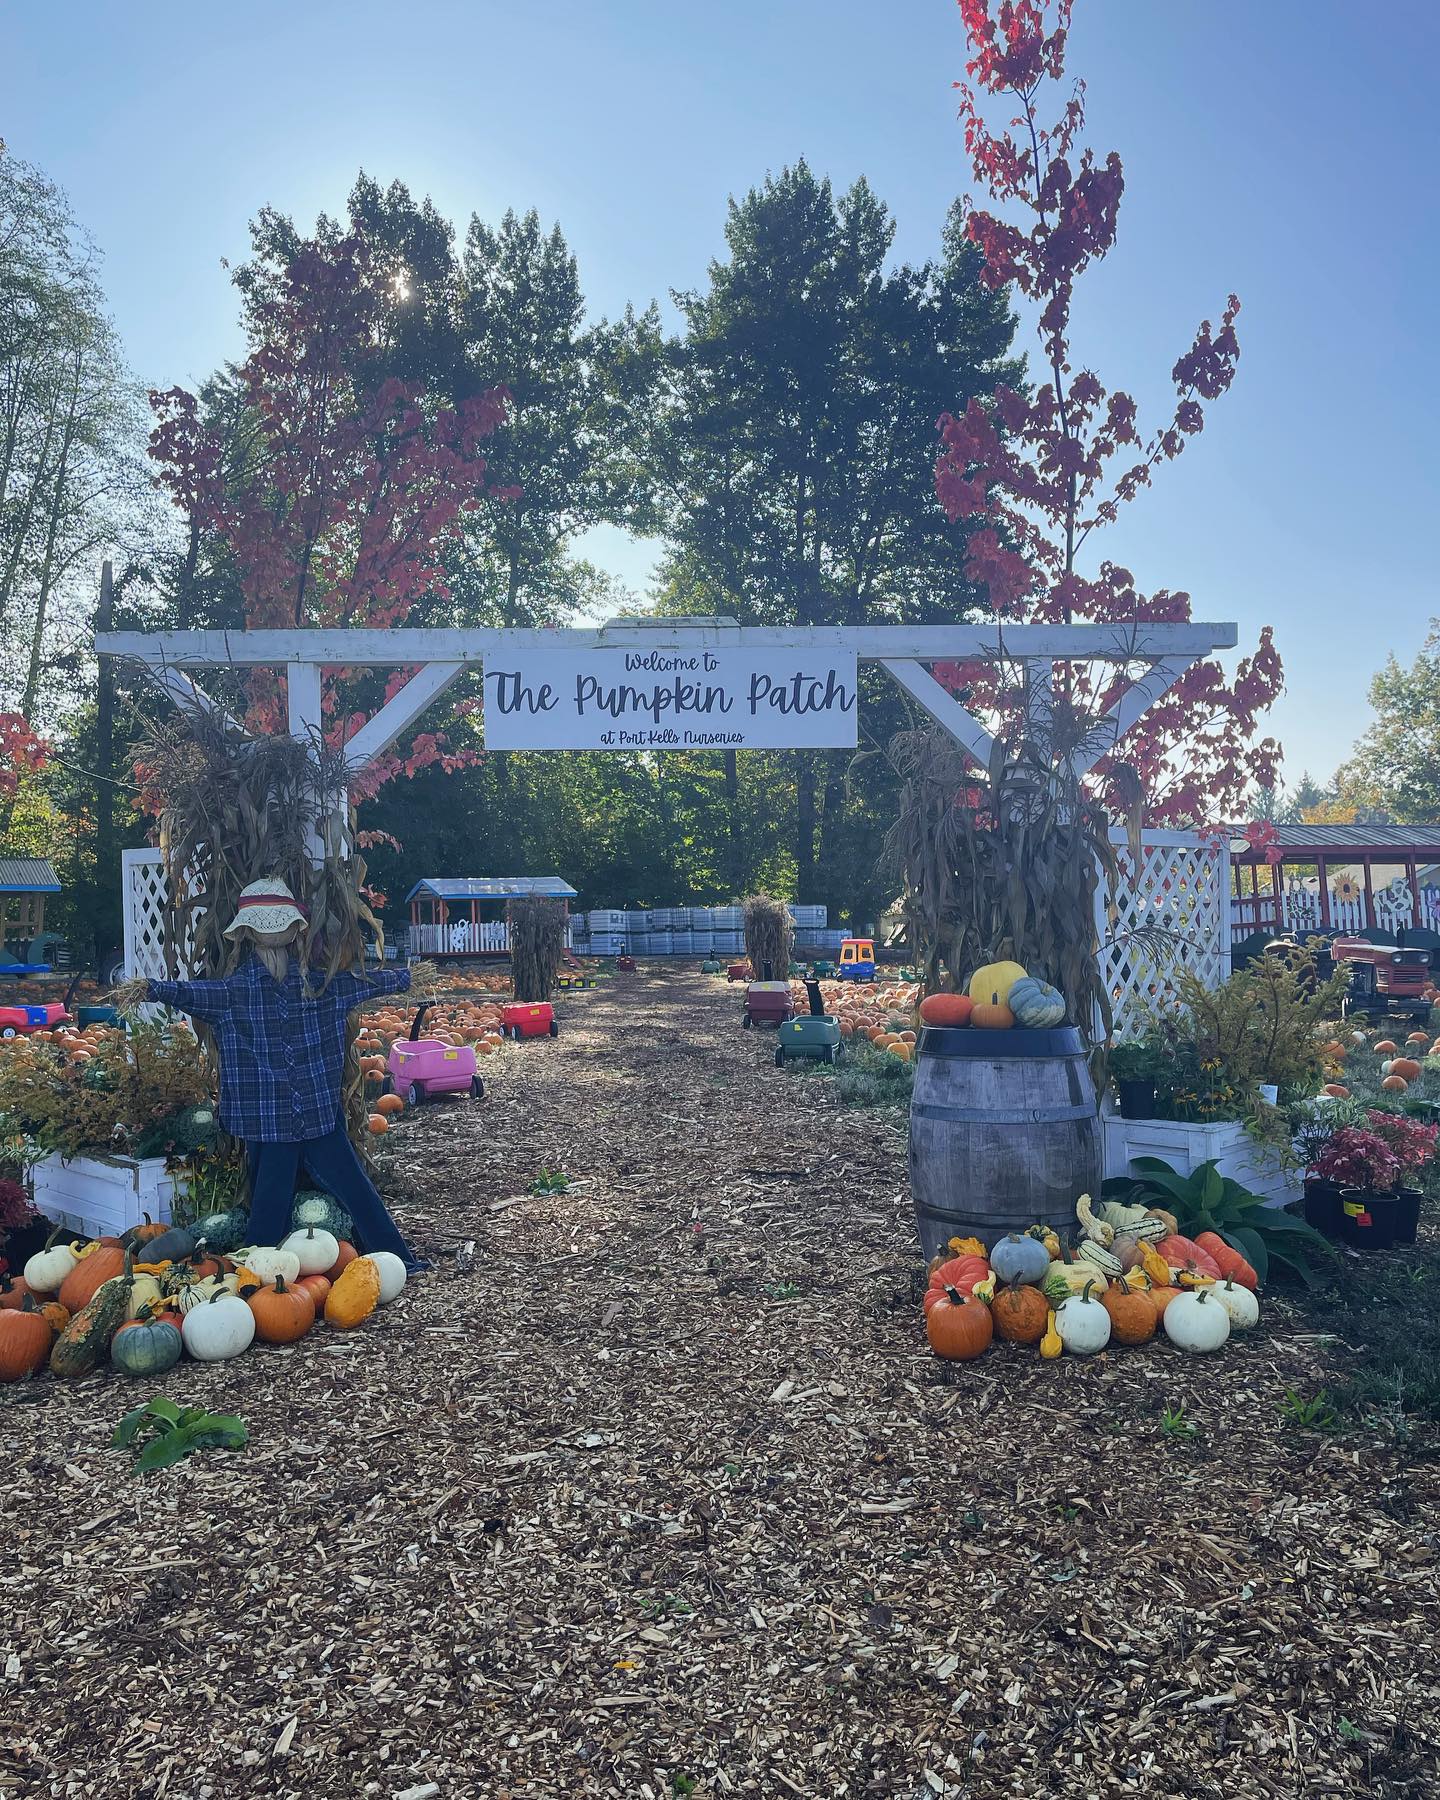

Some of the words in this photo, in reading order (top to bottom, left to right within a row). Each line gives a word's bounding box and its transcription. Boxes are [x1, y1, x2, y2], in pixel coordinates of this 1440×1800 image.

[625, 651, 699, 672] Welcome
[702, 652, 720, 672] to
[485, 671, 559, 715] The
[573, 673, 733, 724] Pumpkin
[747, 669, 856, 715] Patch
[600, 730, 616, 745] at
[619, 730, 646, 745] Port
[647, 729, 680, 745] Kells
[684, 730, 745, 745] Nurseries
